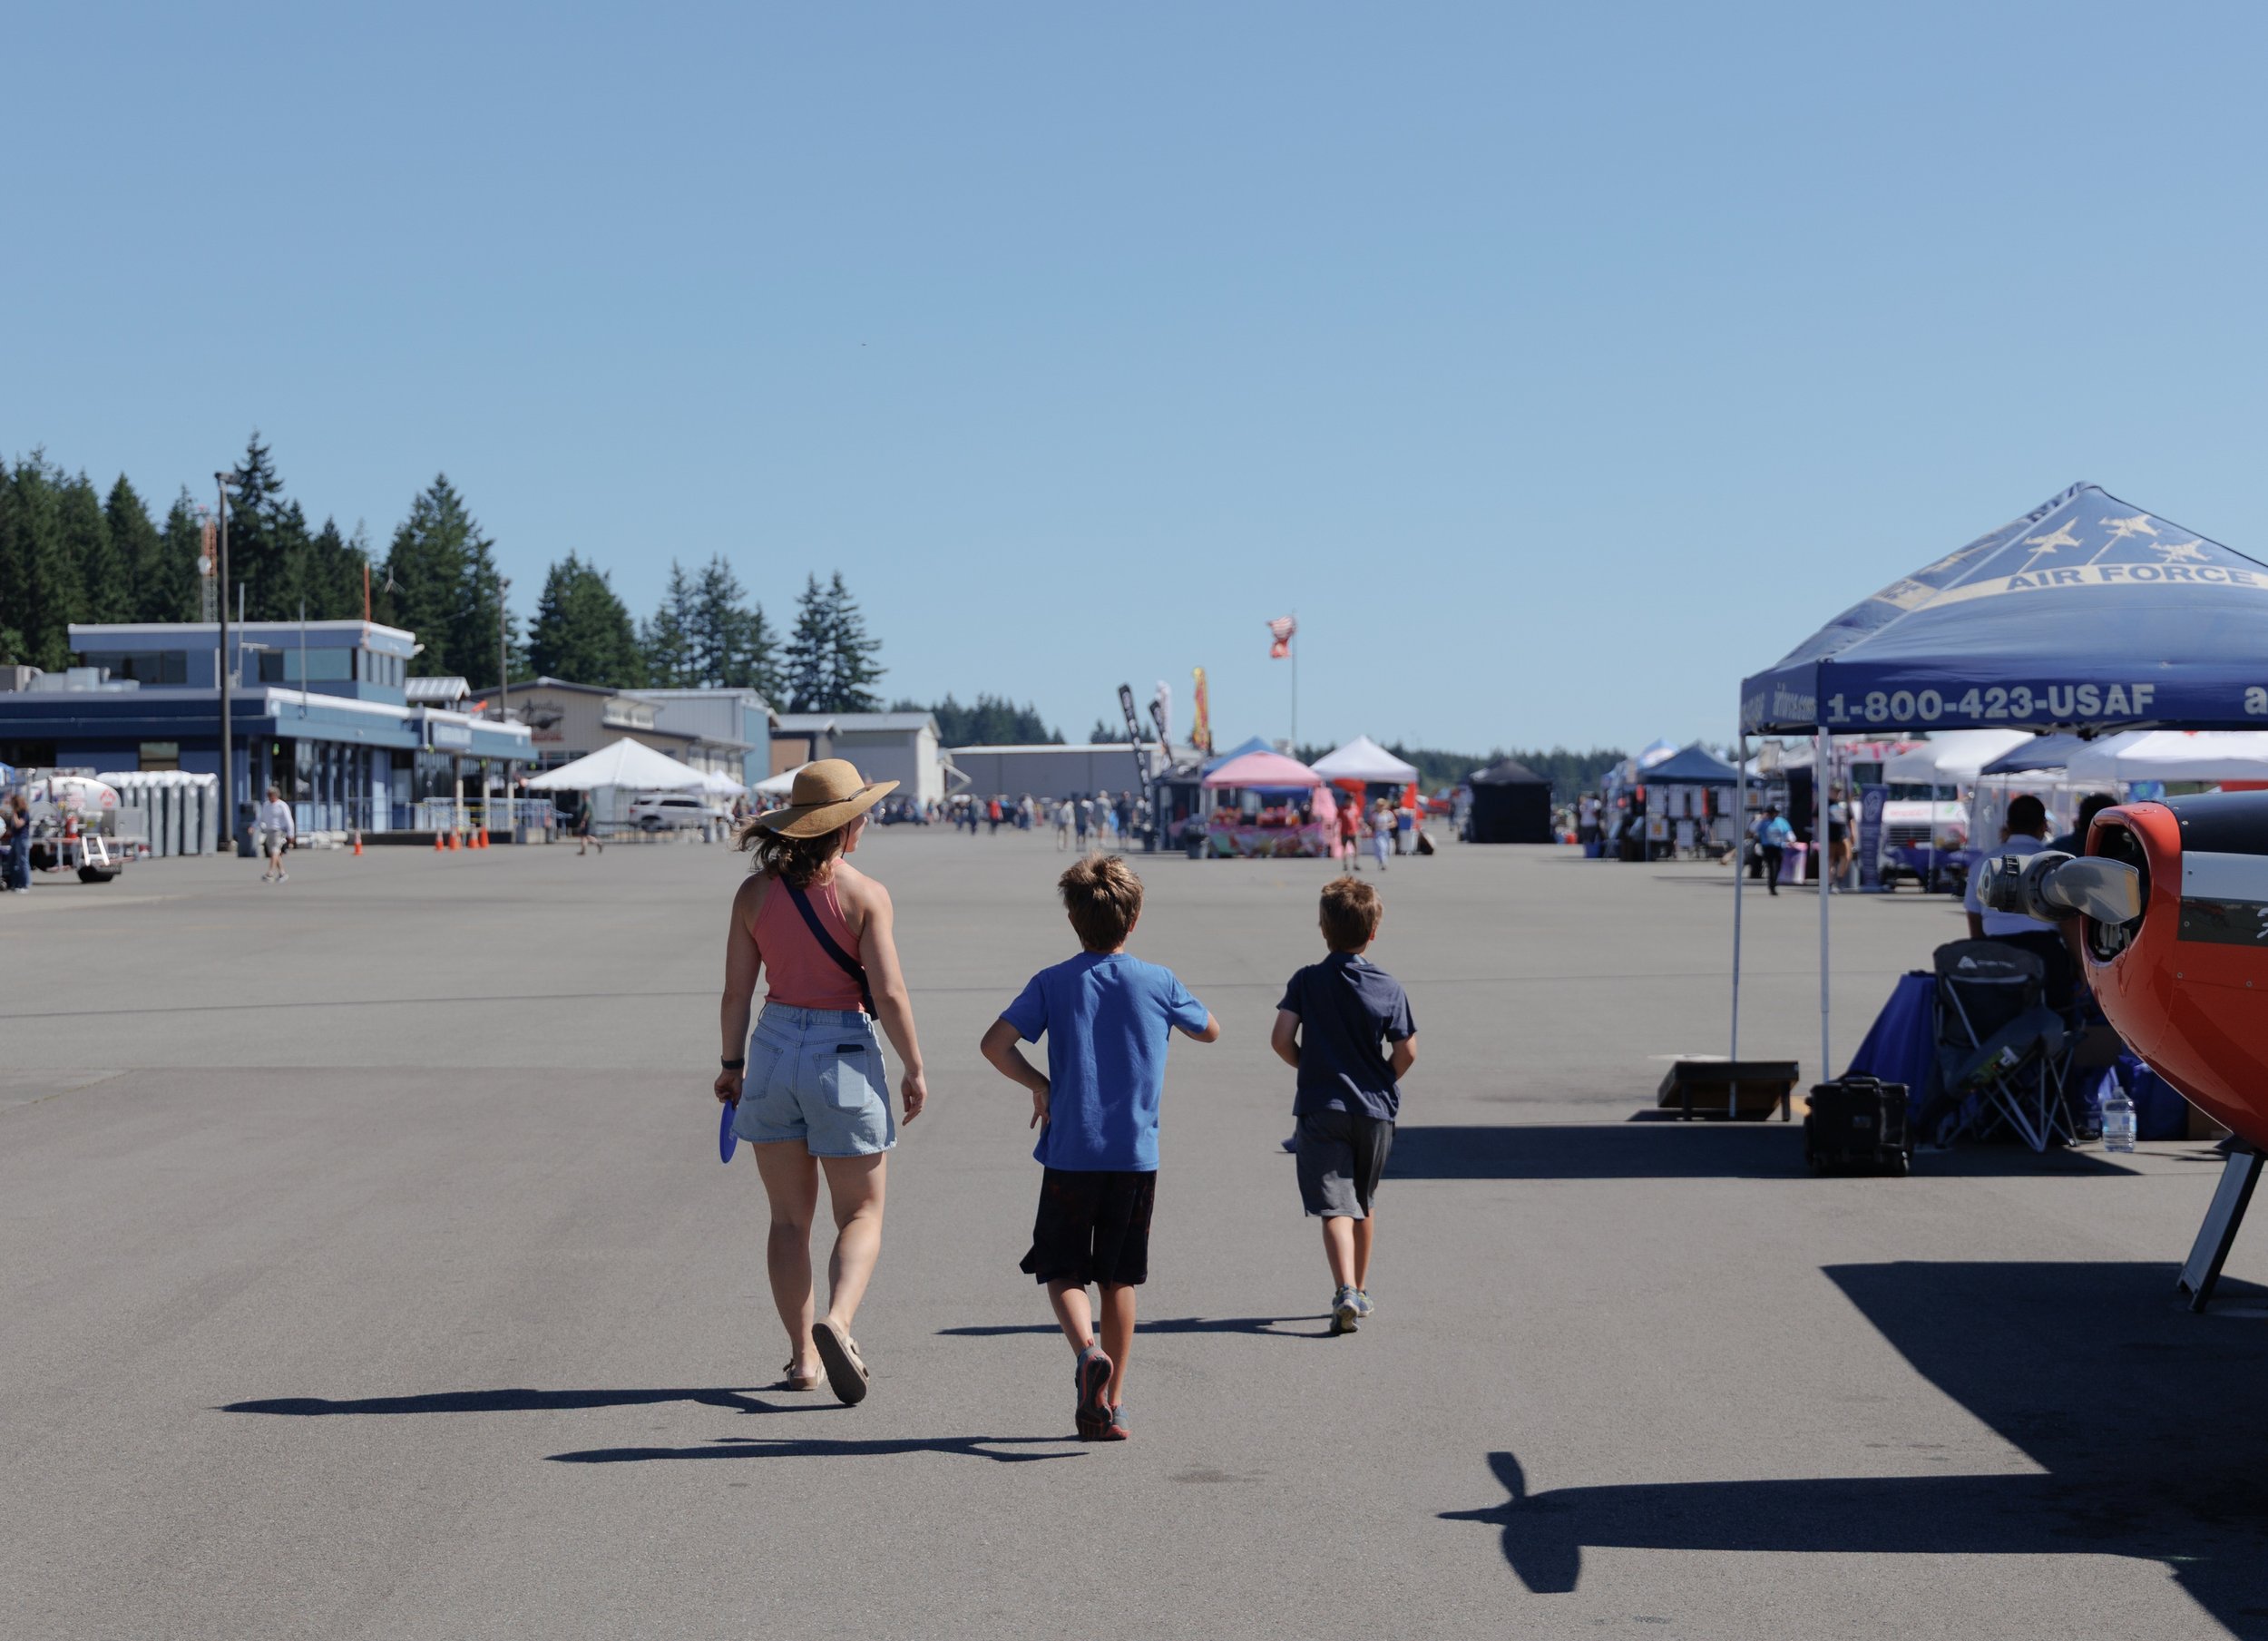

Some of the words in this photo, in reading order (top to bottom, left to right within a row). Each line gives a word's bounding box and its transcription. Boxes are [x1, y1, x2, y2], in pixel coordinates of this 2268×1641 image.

[2006, 569, 2086, 591] AIR
[2097, 565, 2258, 586] FORCE
[1827, 684, 2155, 722] 1-800-423-USAF
